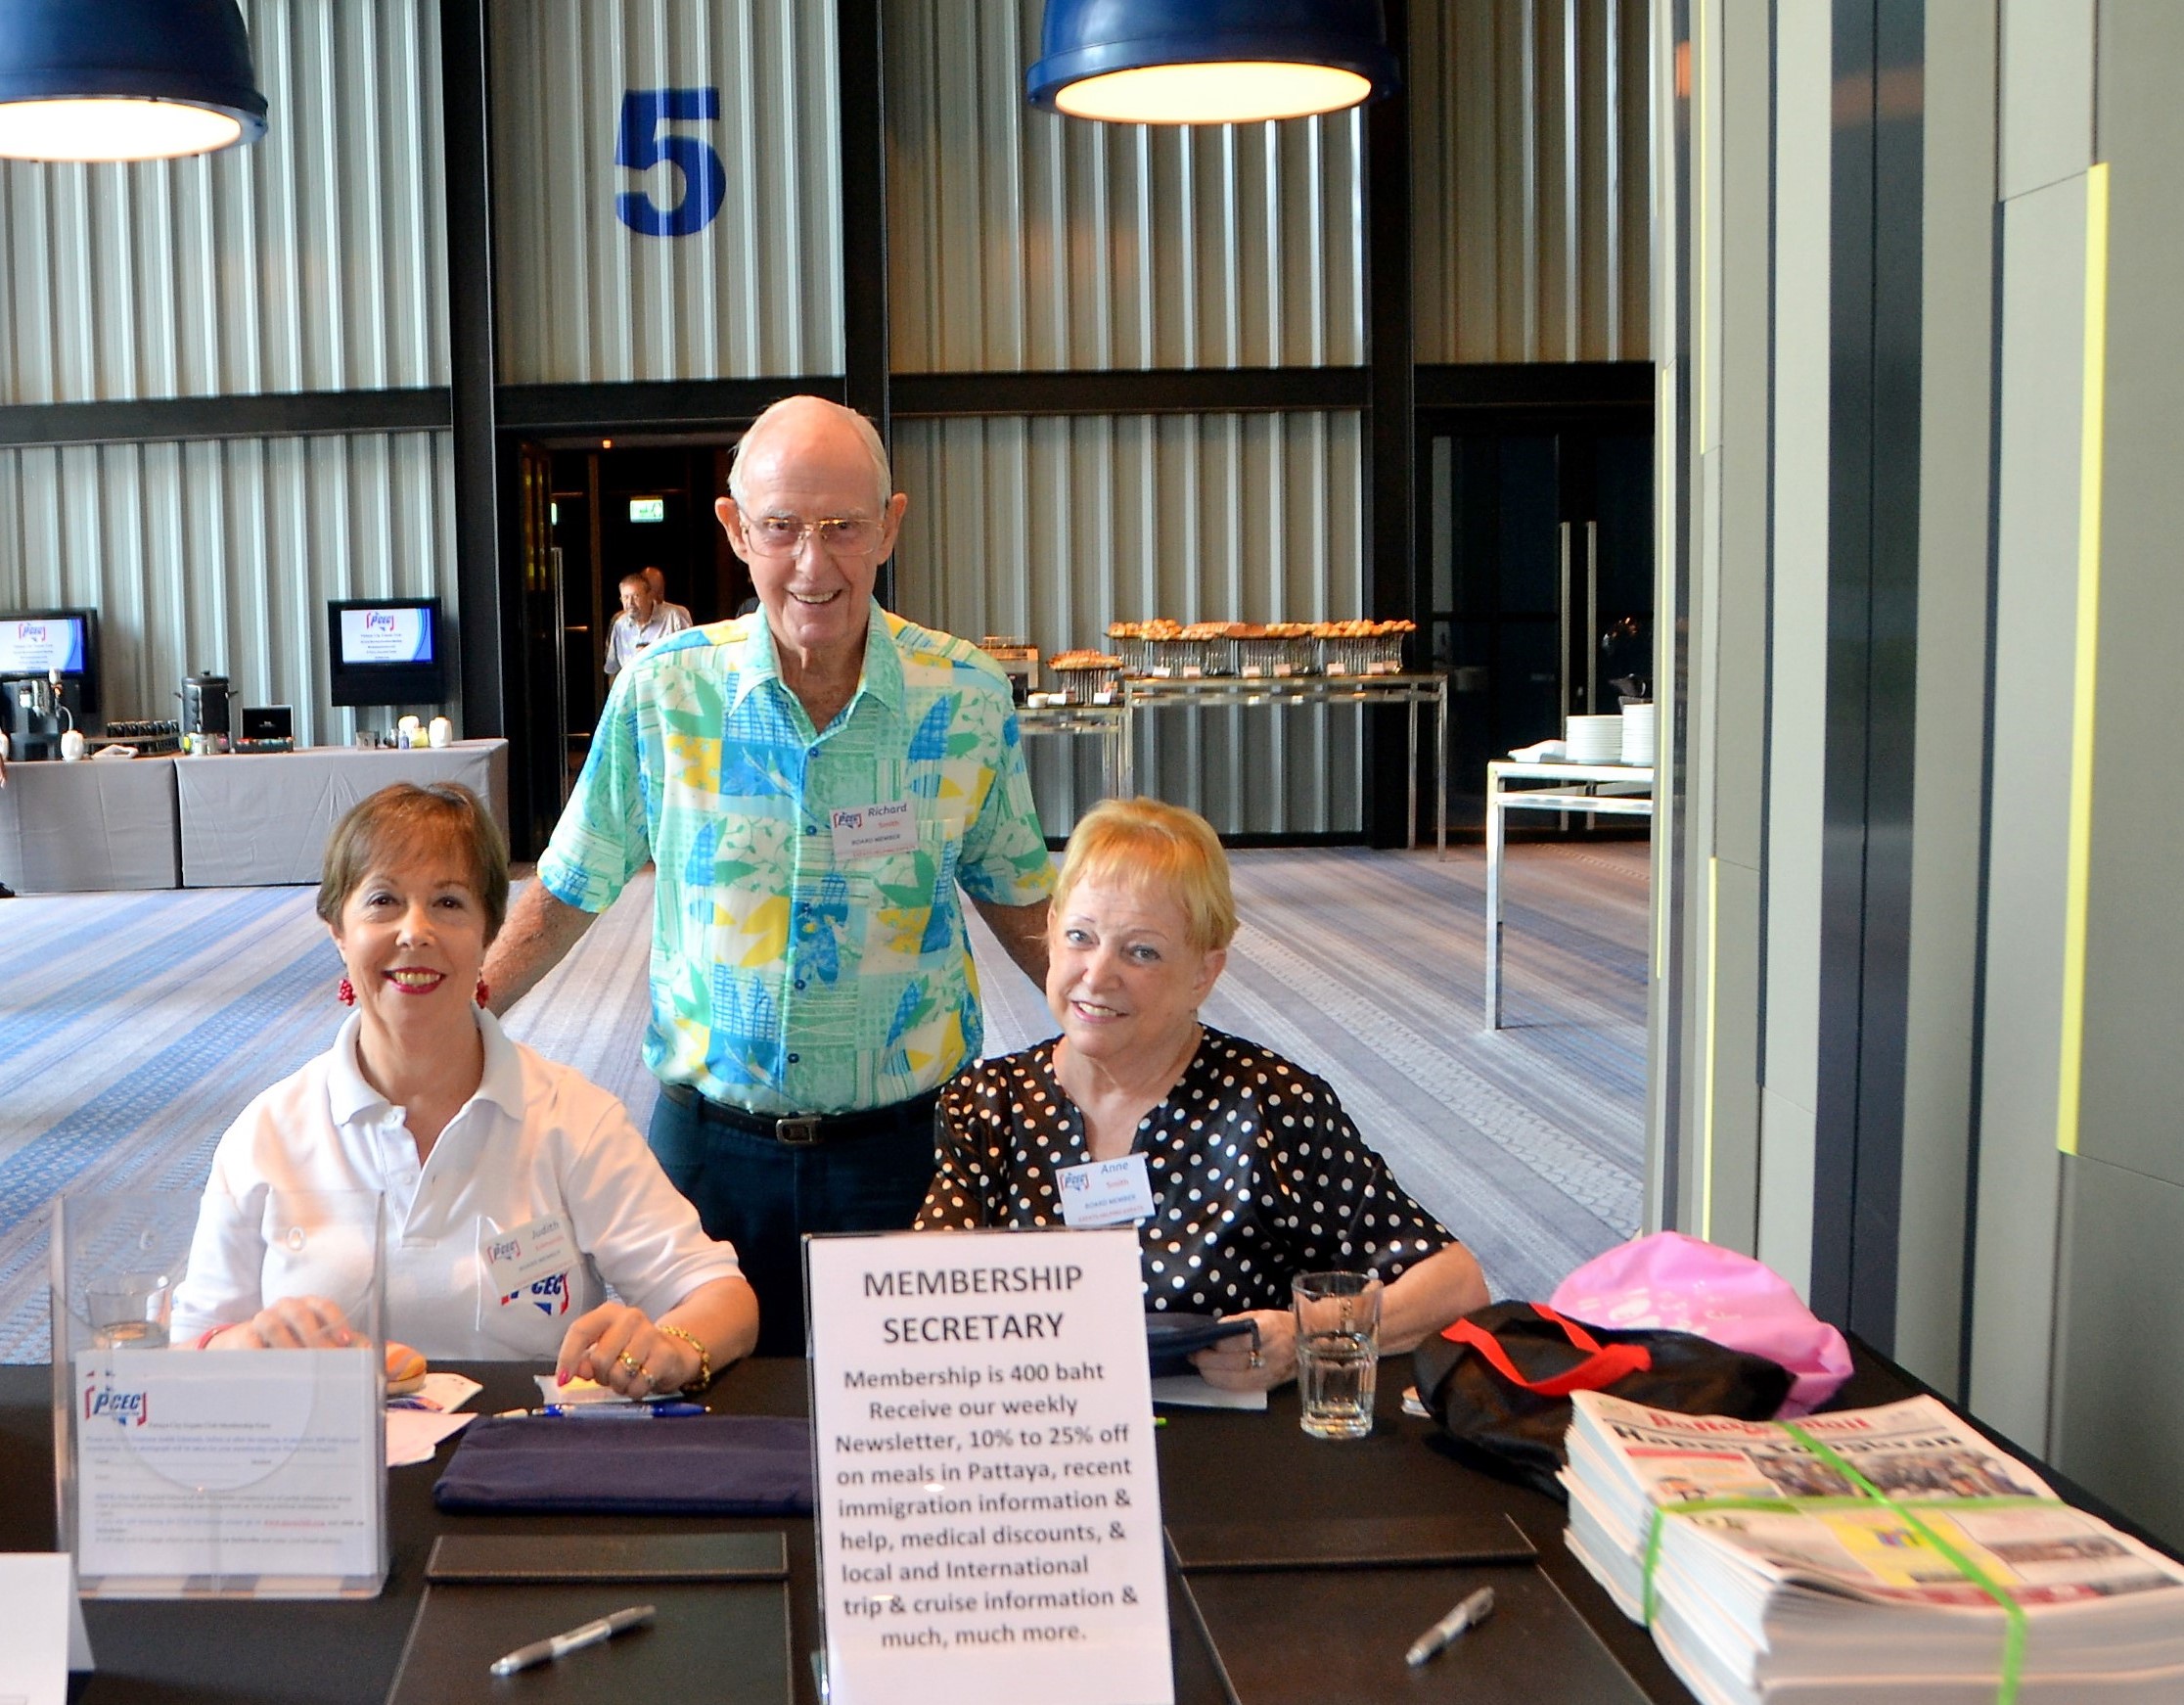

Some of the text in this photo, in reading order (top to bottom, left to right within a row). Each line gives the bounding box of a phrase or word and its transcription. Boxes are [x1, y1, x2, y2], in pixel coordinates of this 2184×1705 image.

[614, 86, 727, 237] 5
[868, 804, 908, 816] Richard
[1101, 1162, 1129, 1175] Anne
[532, 1221, 559, 1239] Judith
[864, 1267, 1082, 1297] MEMBERSHIP
[884, 1313, 1064, 1343] SECRETARY
[844, 1362, 1104, 1388] Membership is 400 baht
[870, 1395, 1076, 1419] Receive our weekly
[836, 1424, 1129, 1452] Newsletter, 10% to 25% off
[838, 1458, 1131, 1485] on meals in Pattaya, recent
[839, 1489, 1131, 1519] immigration information &
[841, 1521, 1125, 1552] help, medical discounts, &
[842, 1555, 1088, 1583] local and International
[843, 1586, 1138, 1618] trip & cruise information &
[881, 1624, 1087, 1648] much, much more.
